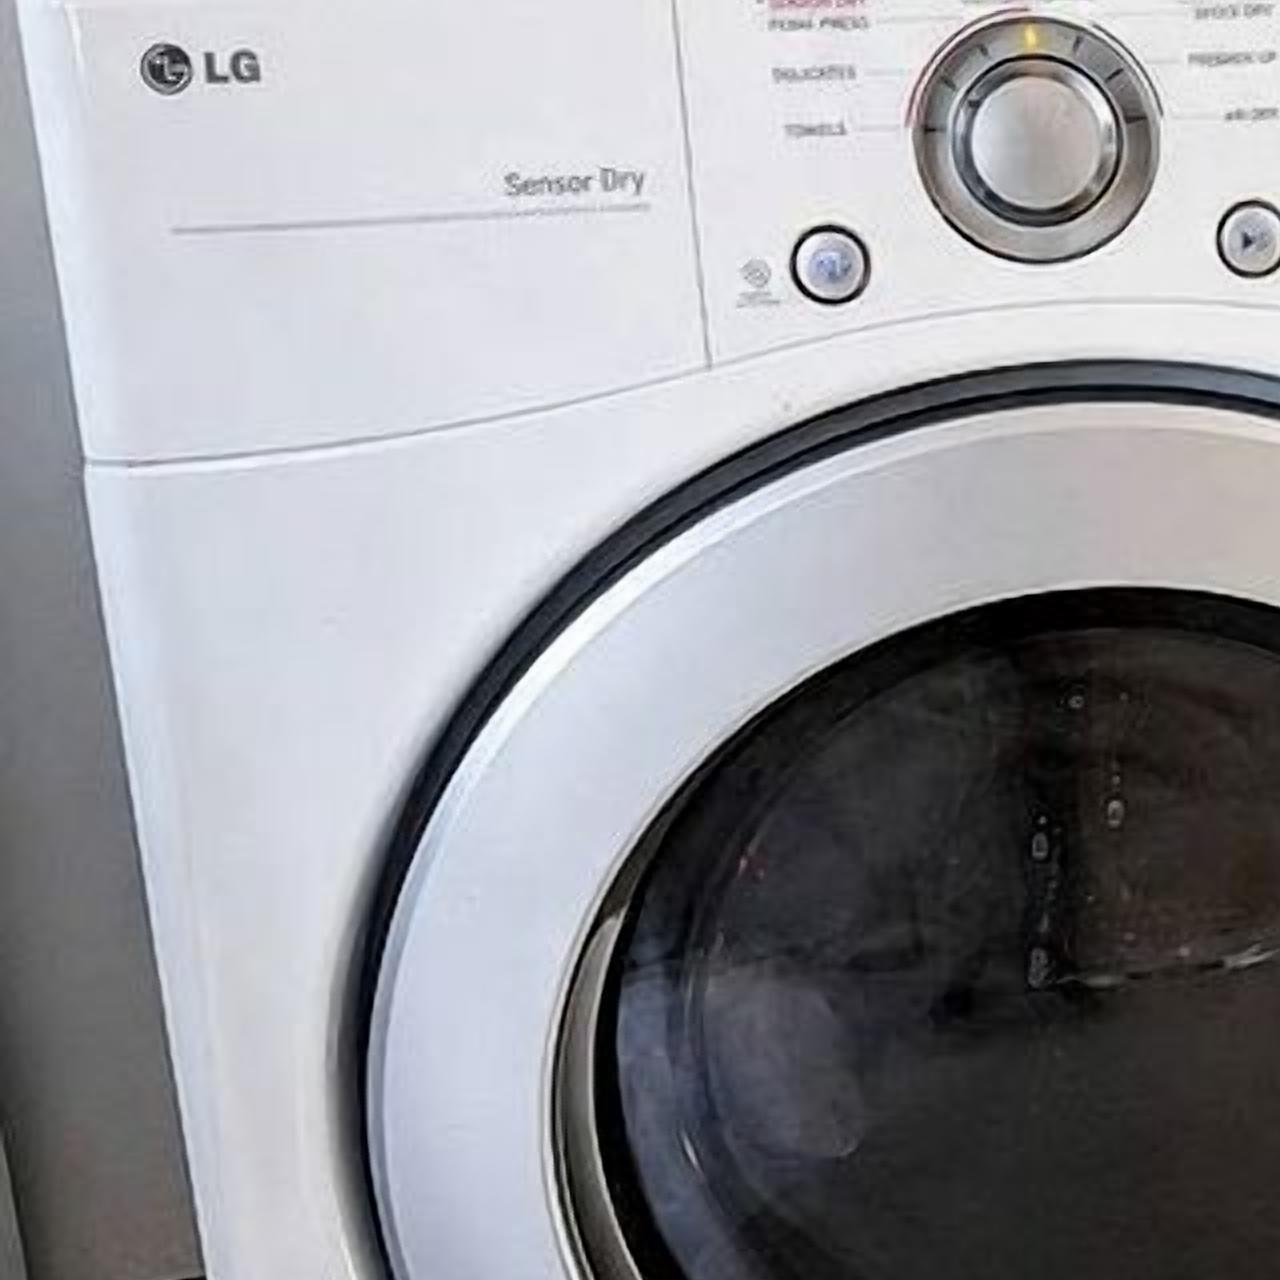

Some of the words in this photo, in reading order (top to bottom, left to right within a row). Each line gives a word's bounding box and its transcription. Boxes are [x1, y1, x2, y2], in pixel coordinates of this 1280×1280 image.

[203, 49, 261, 83] LG
[504, 173, 592, 196] Sensor
[600, 168, 645, 195] Dry
